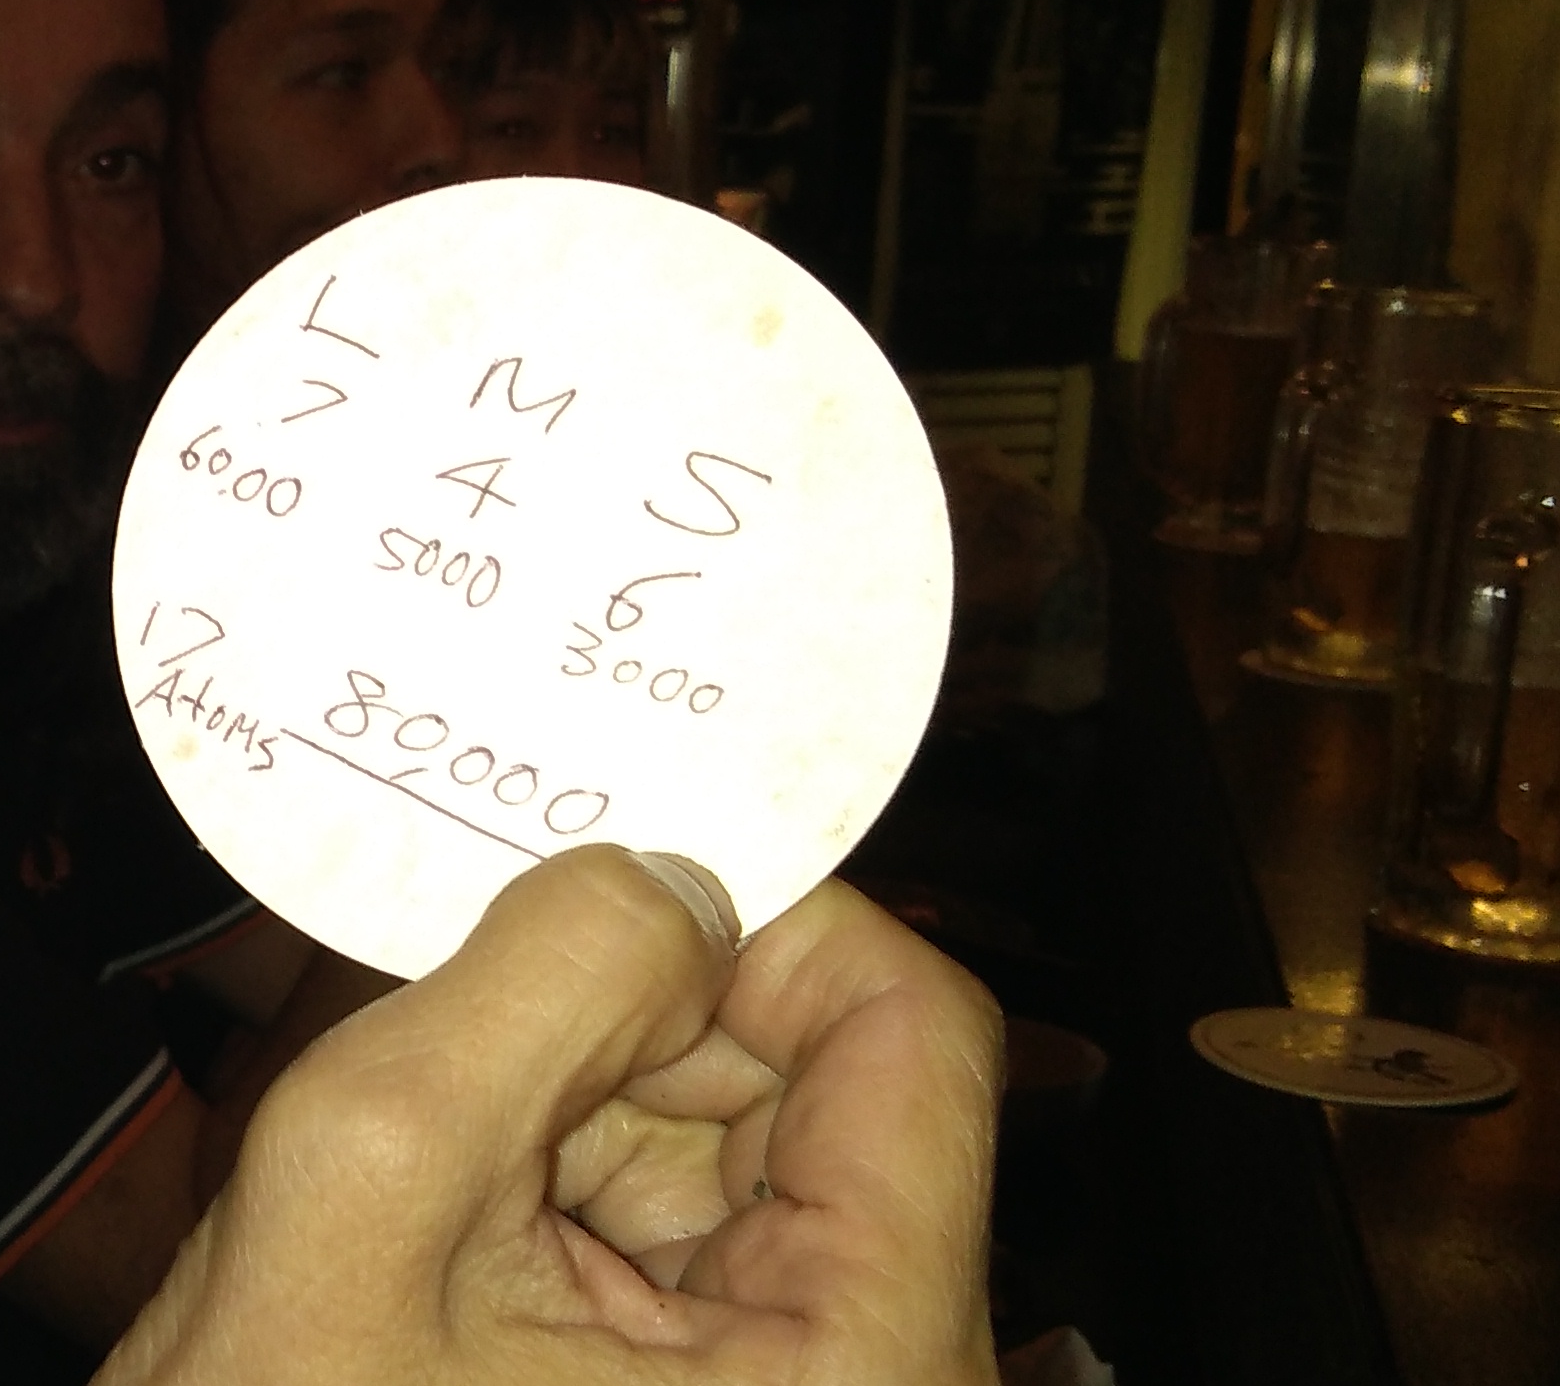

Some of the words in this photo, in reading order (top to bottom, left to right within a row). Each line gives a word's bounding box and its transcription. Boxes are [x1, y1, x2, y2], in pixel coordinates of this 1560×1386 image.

[299, 274, 381, 360] L
[280, 379, 349, 424] 7
[469, 356, 577, 436] M
[435, 457, 517, 519] 4
[643, 451, 773, 537] S
[374, 527, 503, 608] 5000
[605, 571, 703, 632] 6
[139, 601, 226, 668] 17
[560, 621, 725, 715] 3000
